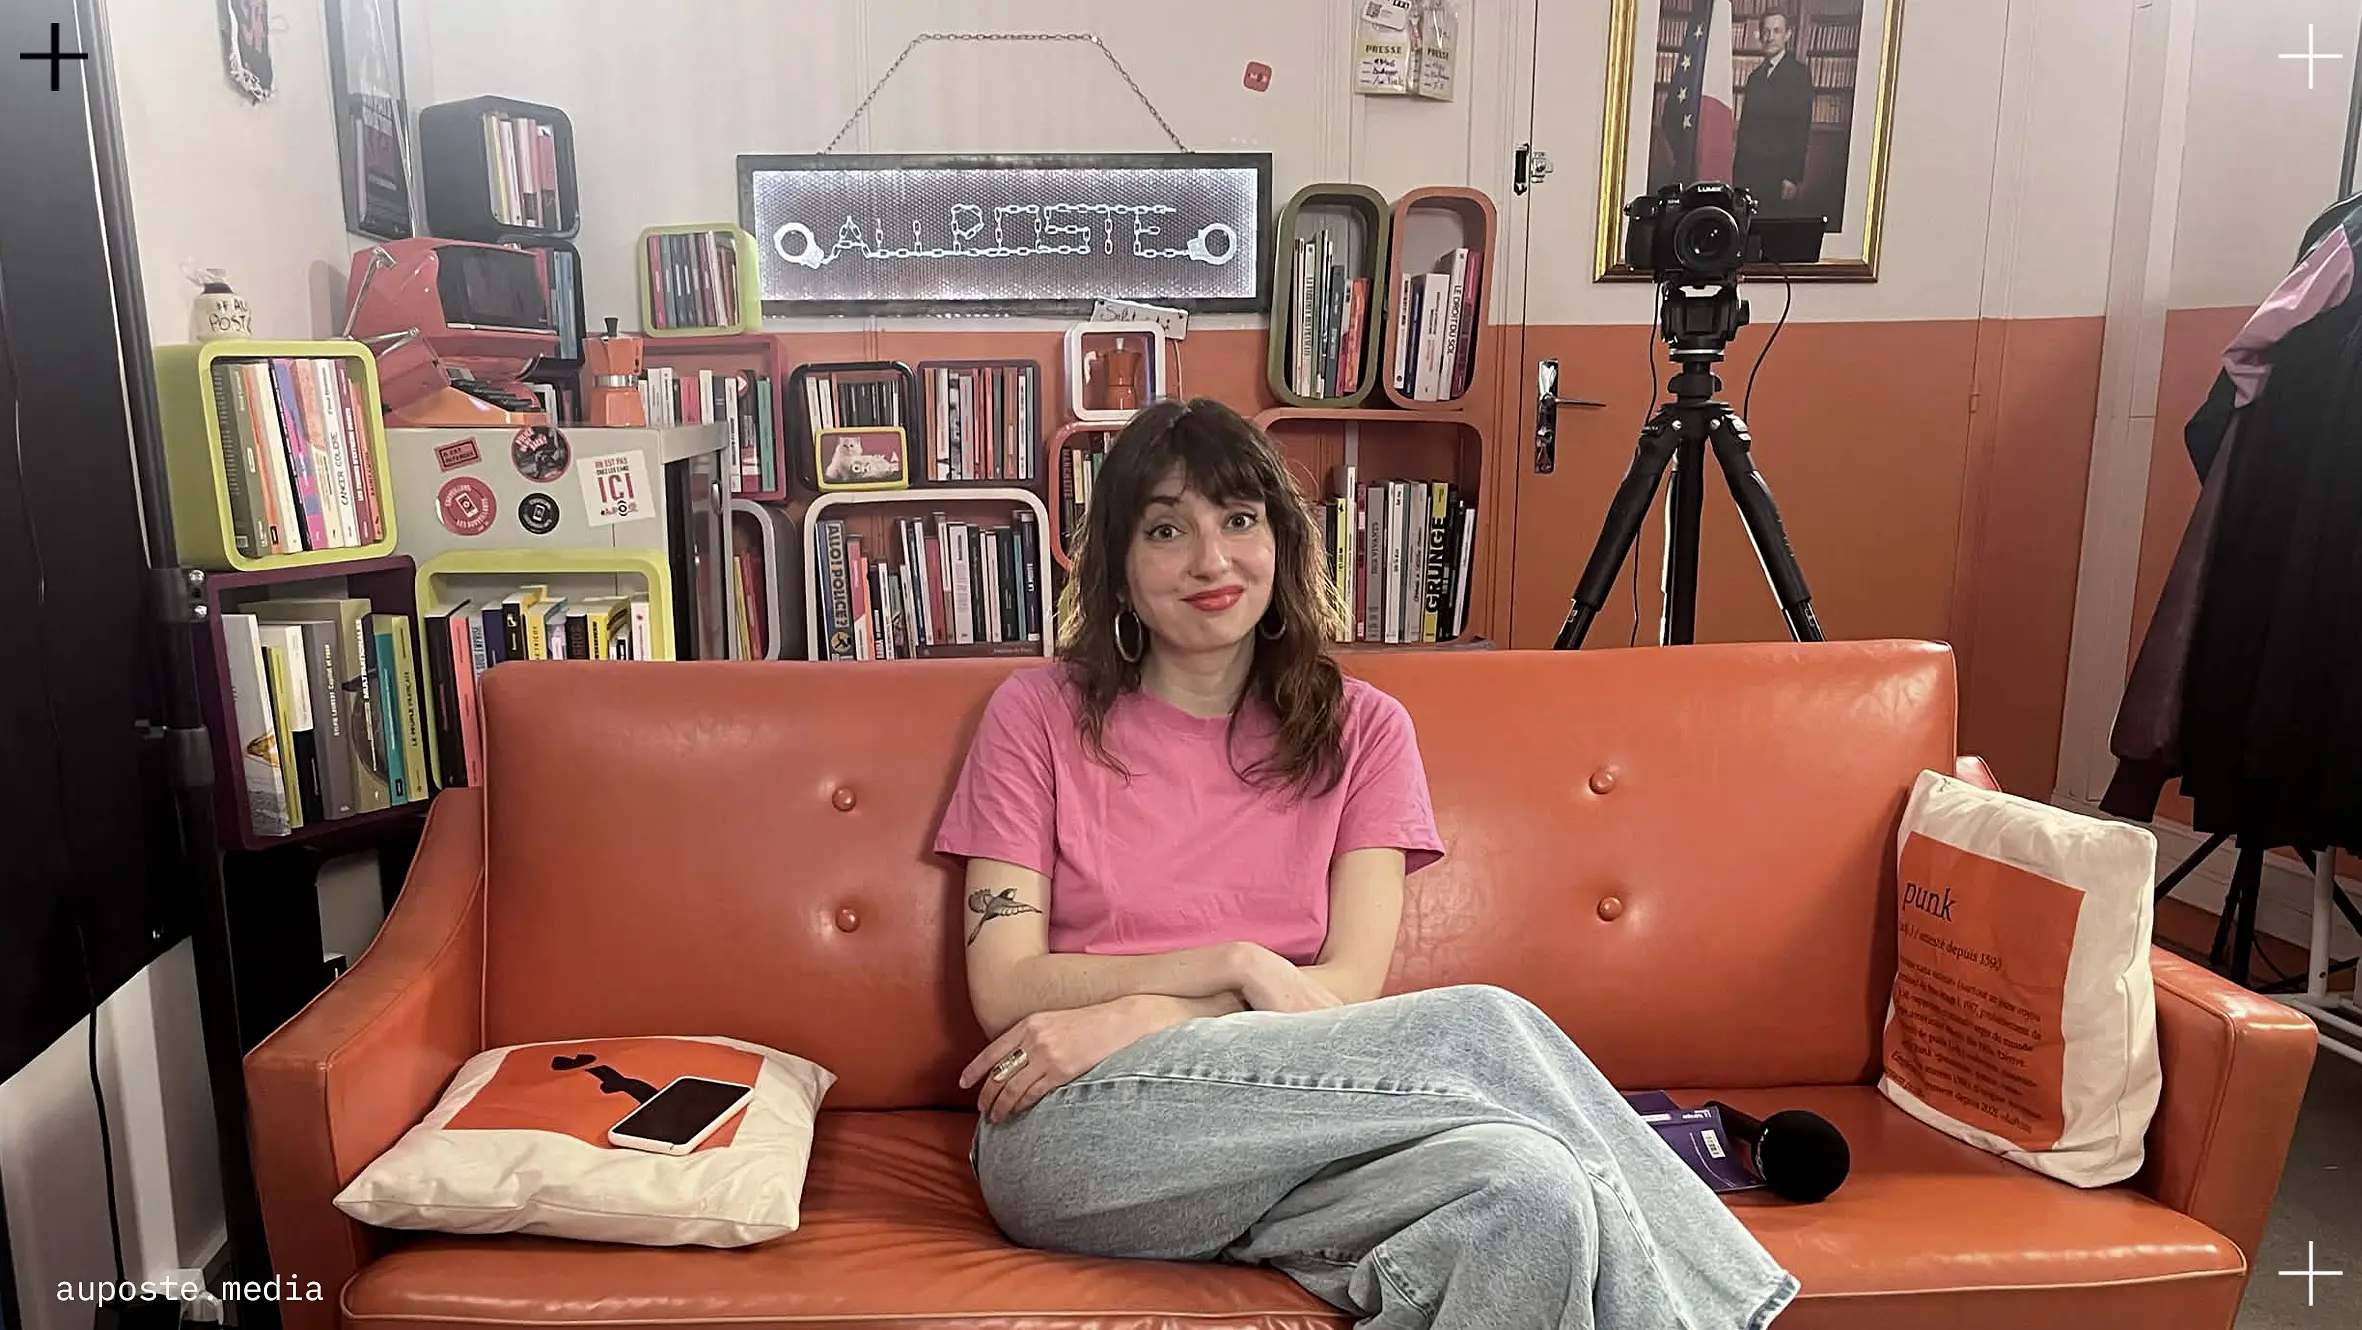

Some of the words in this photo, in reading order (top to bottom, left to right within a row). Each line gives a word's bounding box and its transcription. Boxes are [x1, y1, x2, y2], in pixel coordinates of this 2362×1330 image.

[1366, 44, 1402, 54] PRESSE
[838, 215, 922, 260] AU
[950, 203, 1178, 259] POSTE
[1453, 284, 1462, 295] LE
[1450, 297, 1461, 323] DROIT
[1448, 323, 1457, 338] DU
[1447, 339, 1455, 355] SOL
[338, 471, 349, 505] CANCER
[598, 472, 634, 503] ICI
[1425, 517, 1446, 612] GRUNGE
[831, 569, 848, 626] POLICE?
[408, 709, 416, 735] PEUPLE
[411, 737, 417, 747] LE
[1903, 882, 1956, 922] punk
[1946, 940, 1978, 962] depuis
